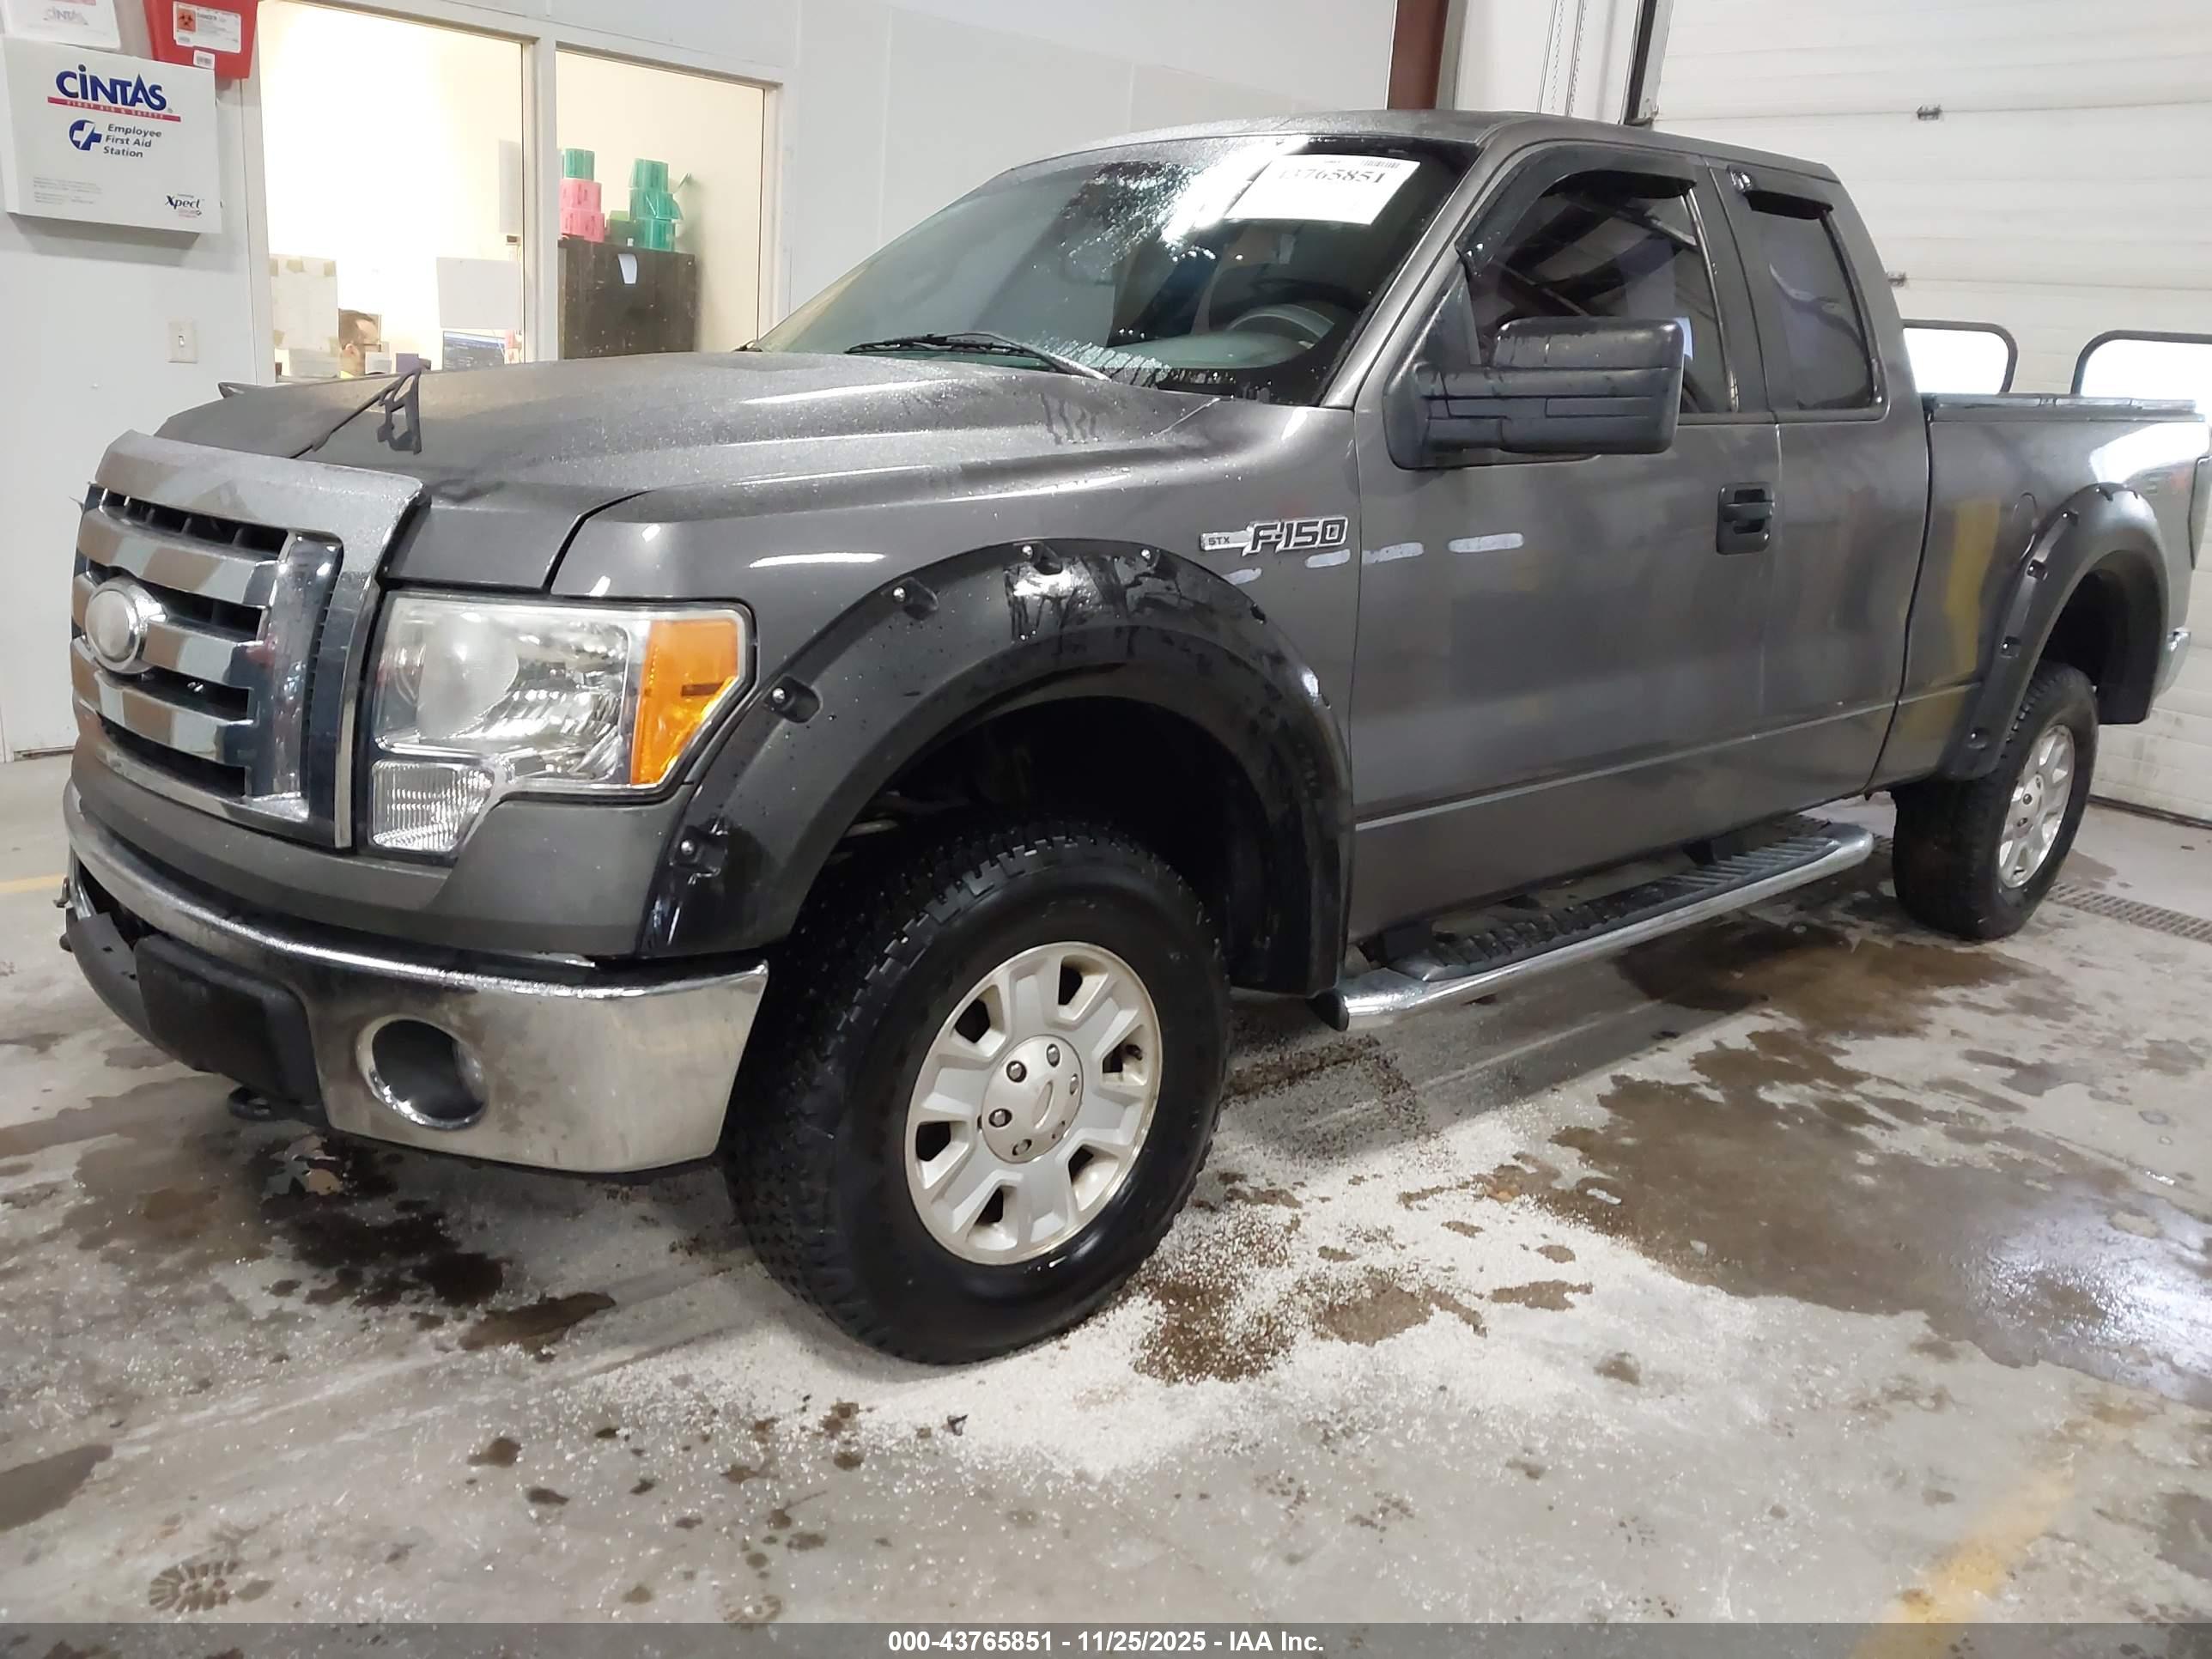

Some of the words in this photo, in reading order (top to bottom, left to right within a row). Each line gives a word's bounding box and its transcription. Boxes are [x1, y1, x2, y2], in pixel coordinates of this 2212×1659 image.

[55, 64, 167, 112] CINTAS
[107, 124, 162, 138] Employee
[106, 135, 130, 145] First
[133, 137, 152, 148] Aid
[103, 146, 143, 158] Station
[1279, 168, 1386, 183] 3765851
[165, 195, 200, 210] Xpect
[1208, 536, 1231, 546] STX
[1249, 518, 1347, 552] F-150
